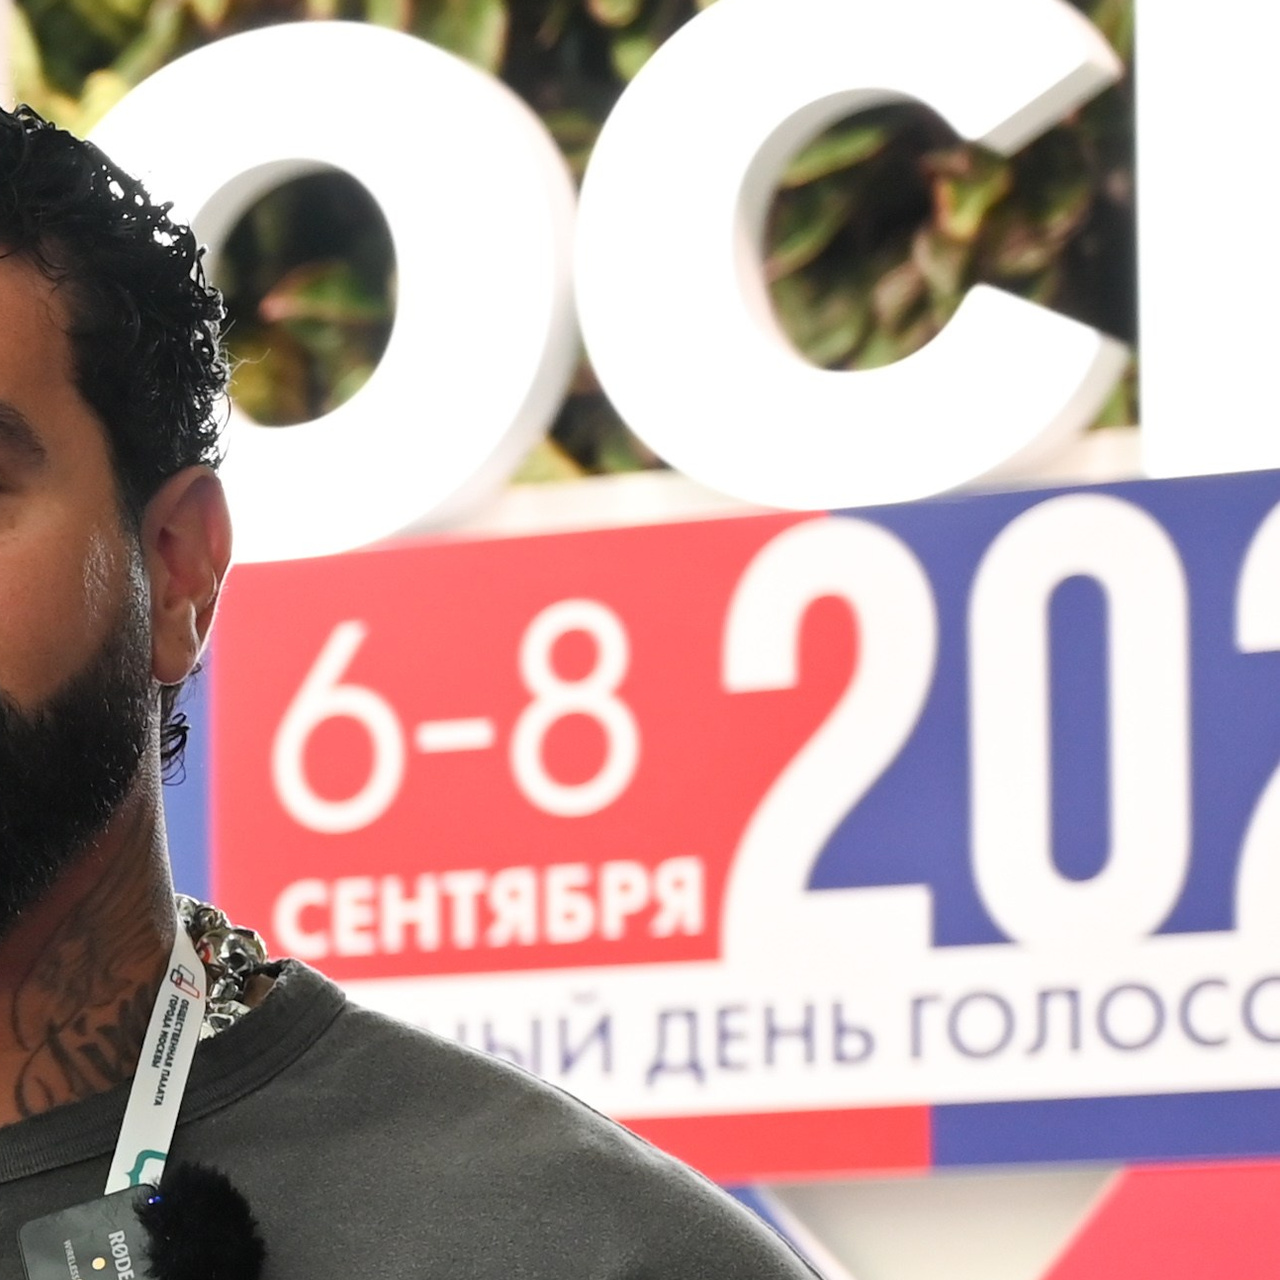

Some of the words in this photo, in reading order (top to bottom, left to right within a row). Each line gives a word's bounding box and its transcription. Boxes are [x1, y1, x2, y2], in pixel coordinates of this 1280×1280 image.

[723, 494, 1280, 962] 20
[273, 857, 703, 957] СЕНТЯБРЯ
[162, 994, 179, 1028] ГОРОДА
[164, 999, 190, 1068] ОБЩЕСТВЕННАЯ
[151, 1030, 169, 1068] МОСКВЫ
[644, 1000, 876, 1087] ДЕНЬ
[153, 1069, 170, 1106] ПАЛАТА
[63, 1239, 80, 1280] WIRELESS
